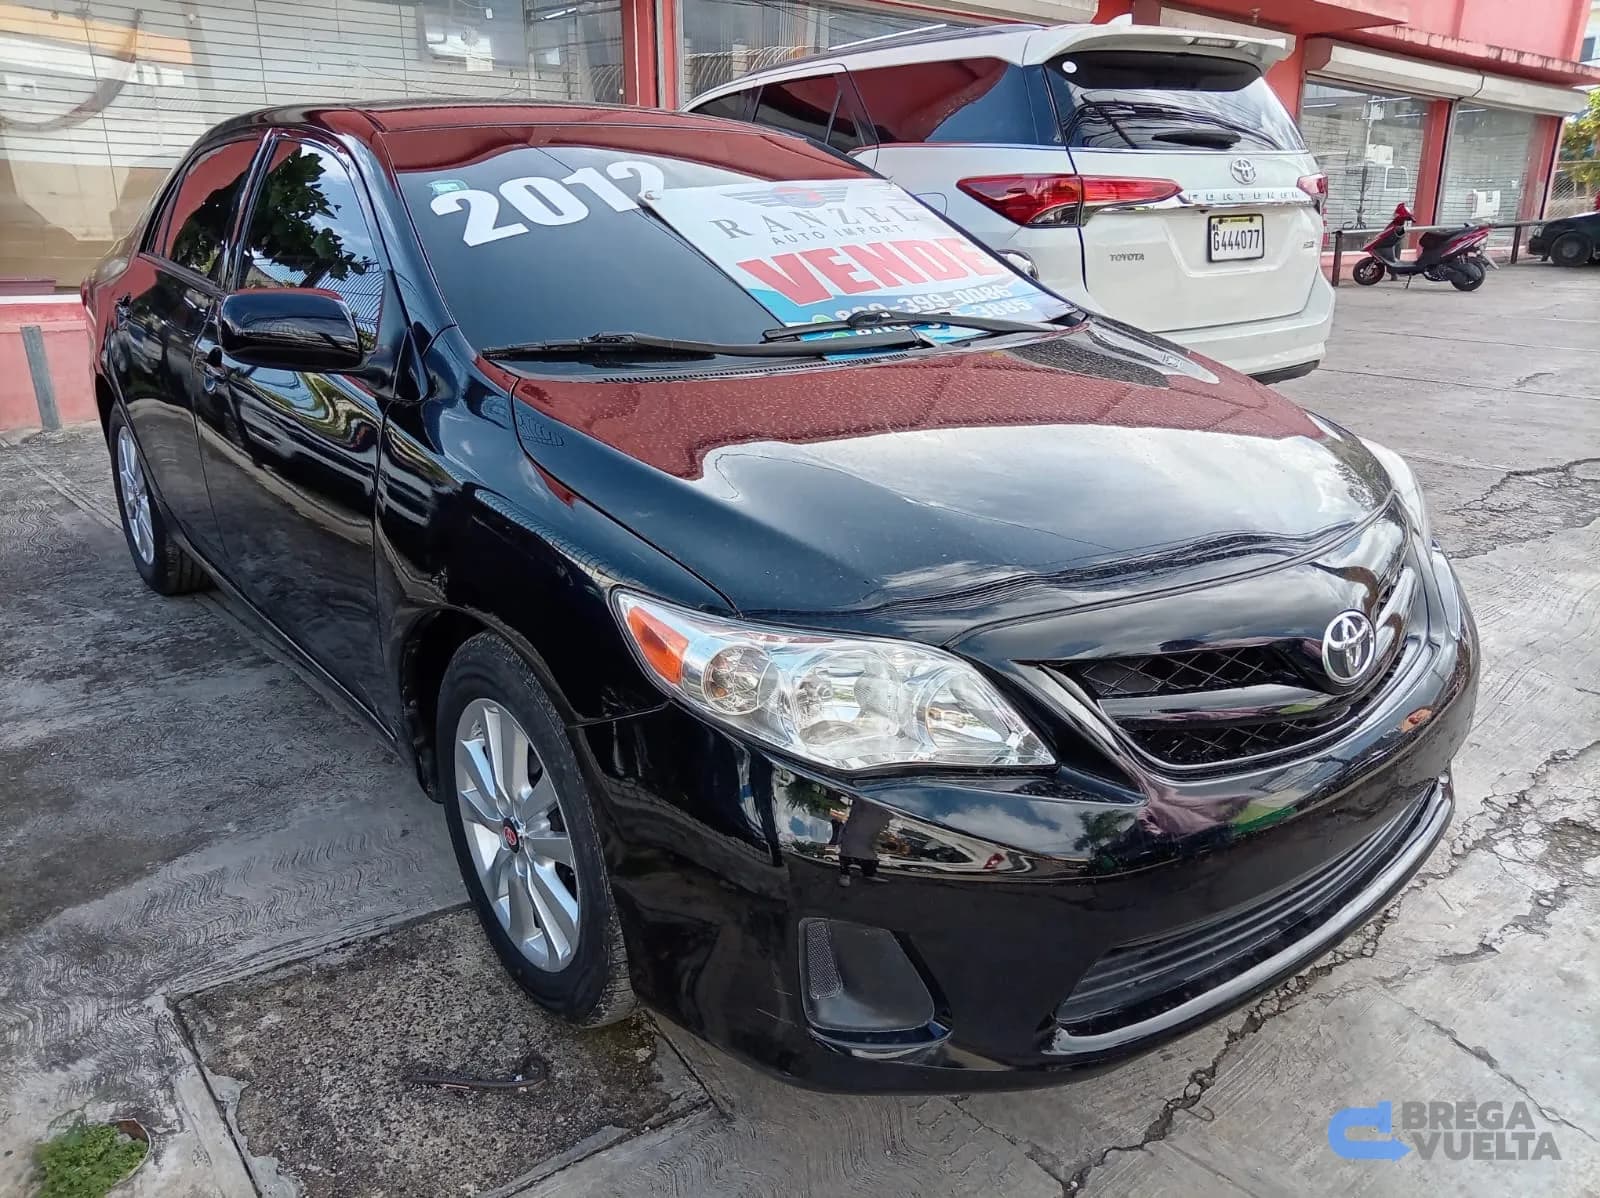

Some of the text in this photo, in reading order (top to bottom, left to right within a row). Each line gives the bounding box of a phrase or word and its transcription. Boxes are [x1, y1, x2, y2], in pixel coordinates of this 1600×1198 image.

[708, 205, 920, 239] RANZEL
[771, 224, 905, 245] AUTO IMPORT
[1213, 229, 1260, 251] G444077
[1110, 253, 1145, 262] TOYOTA
[736, 238, 1003, 305] VENDE
